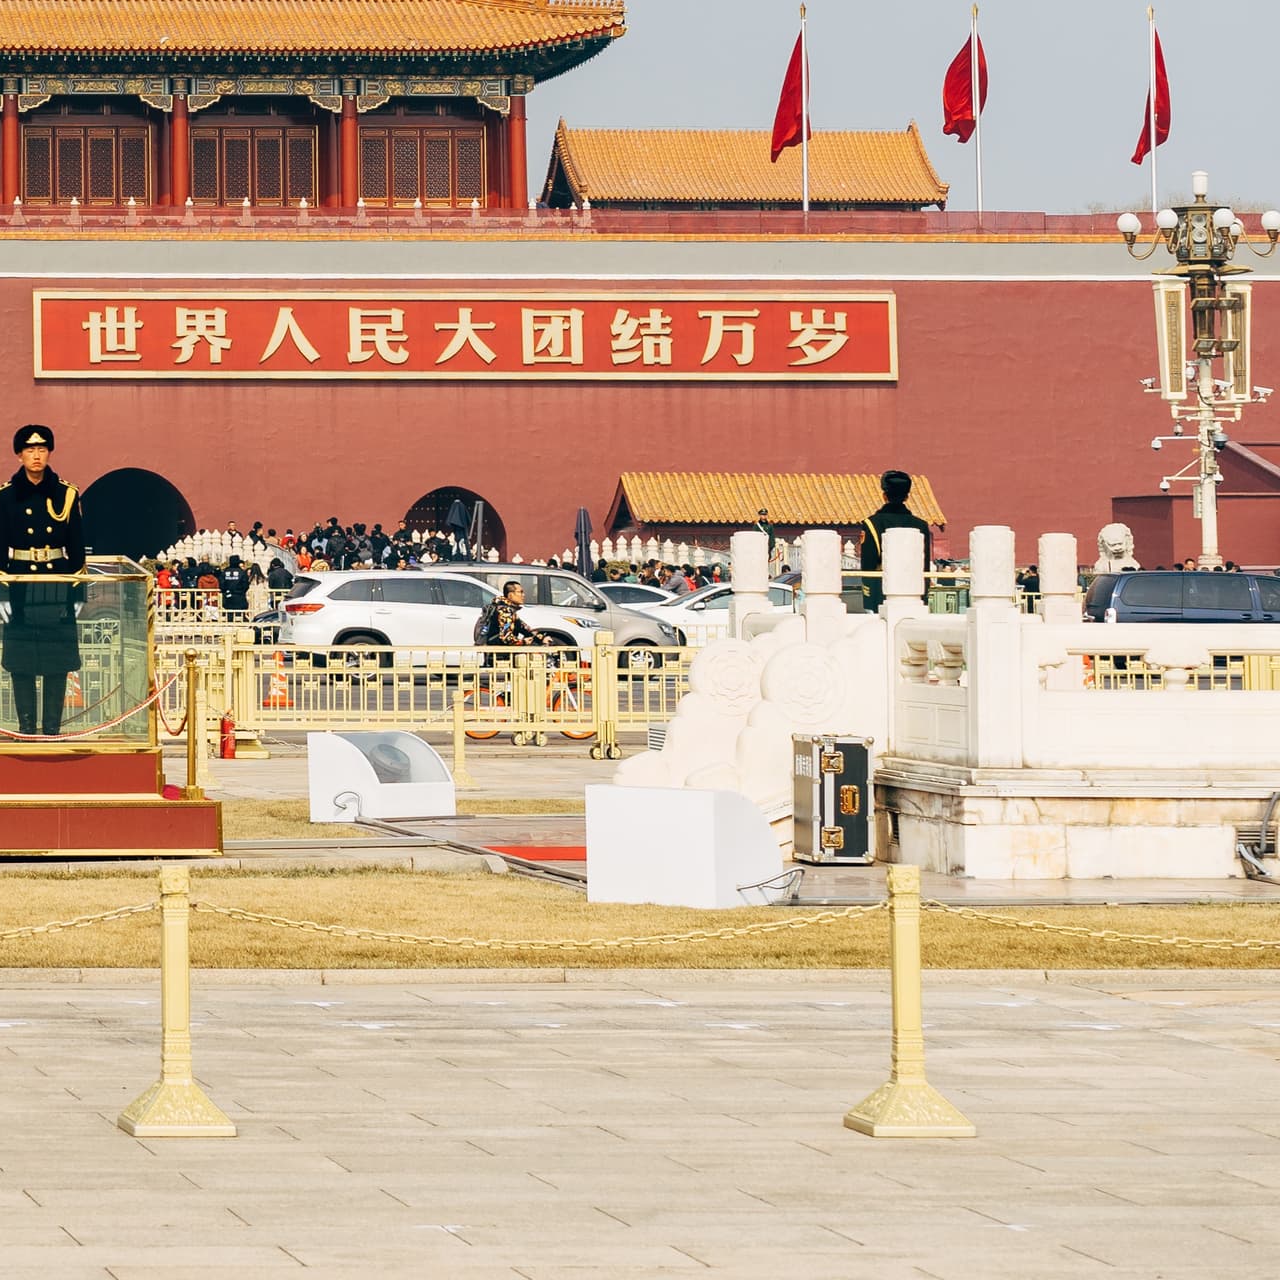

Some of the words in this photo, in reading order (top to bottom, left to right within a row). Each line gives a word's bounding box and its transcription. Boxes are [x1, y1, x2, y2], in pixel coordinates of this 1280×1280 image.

[81, 306, 850, 366] 世界人民大团结万岁
